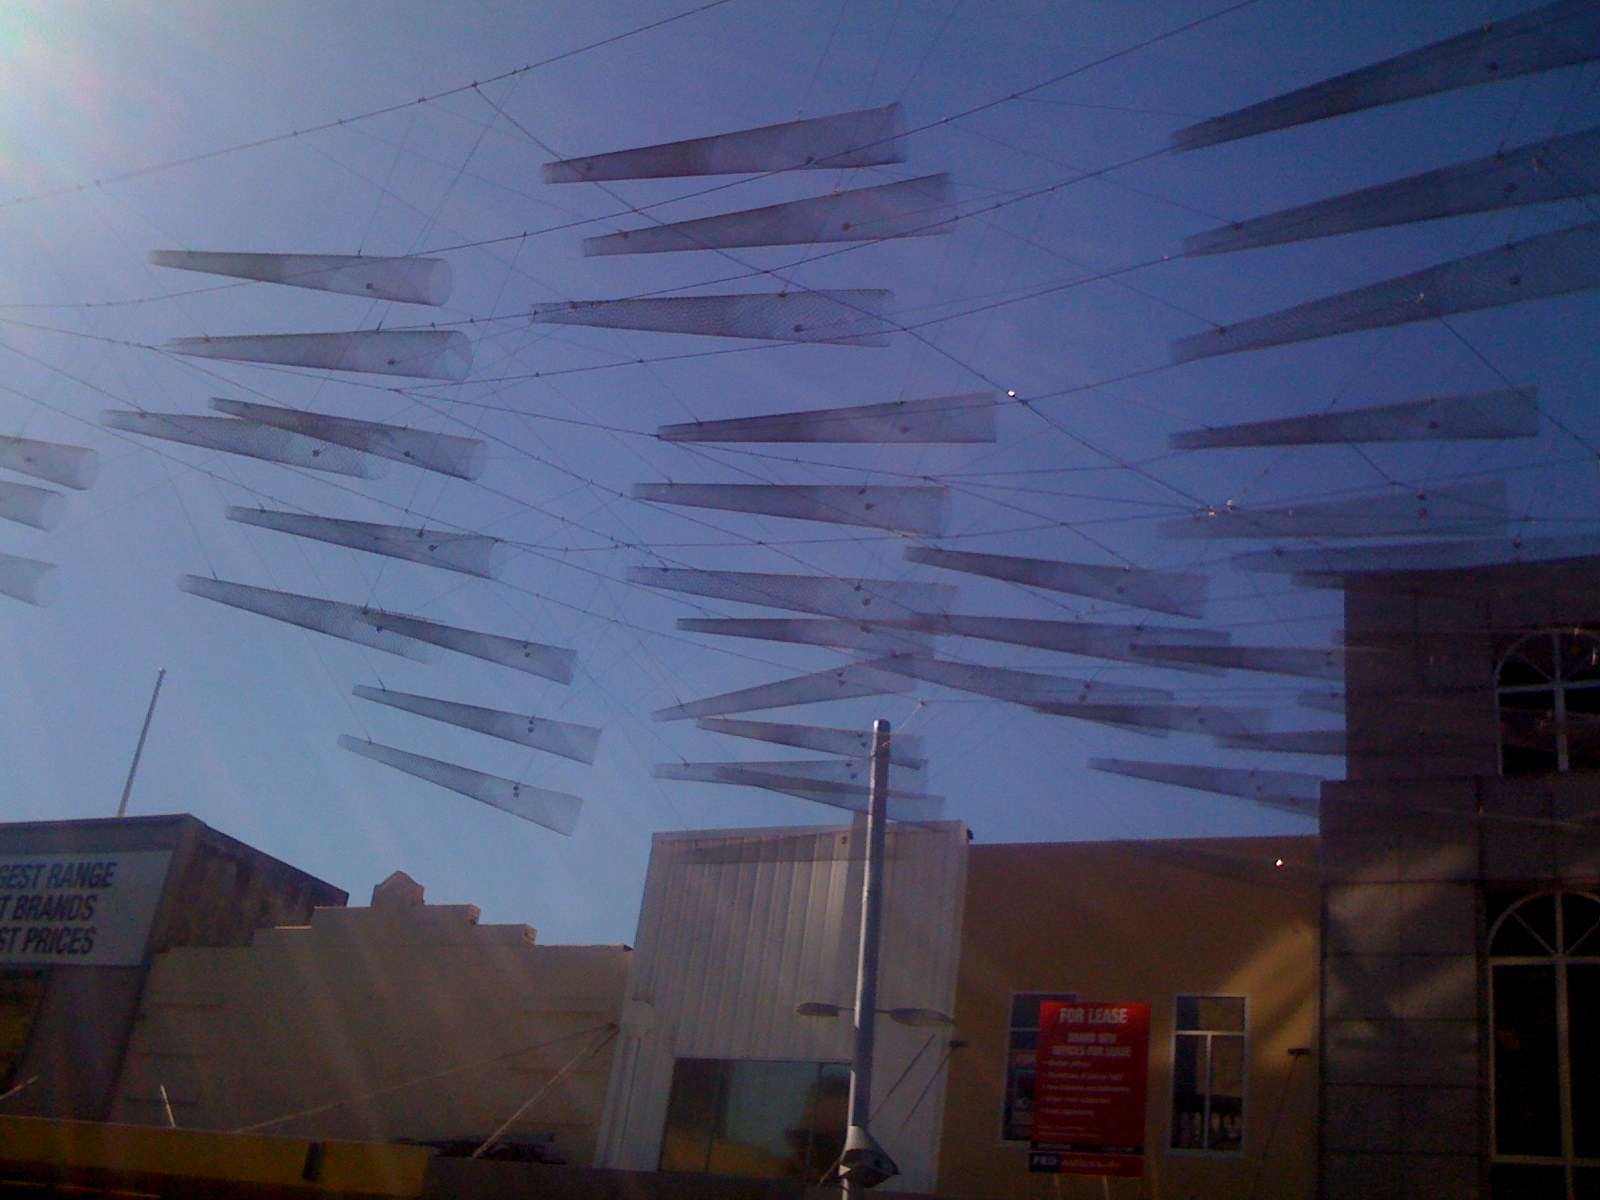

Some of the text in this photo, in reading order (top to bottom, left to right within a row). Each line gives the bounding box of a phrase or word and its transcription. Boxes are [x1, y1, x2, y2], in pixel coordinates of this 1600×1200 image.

[47, 861, 117, 887] RANGE
[13, 894, 97, 920] BRANDS
[22, 927, 97, 954] PRICES
[1059, 1008, 1128, 1024] FOR LEASE
